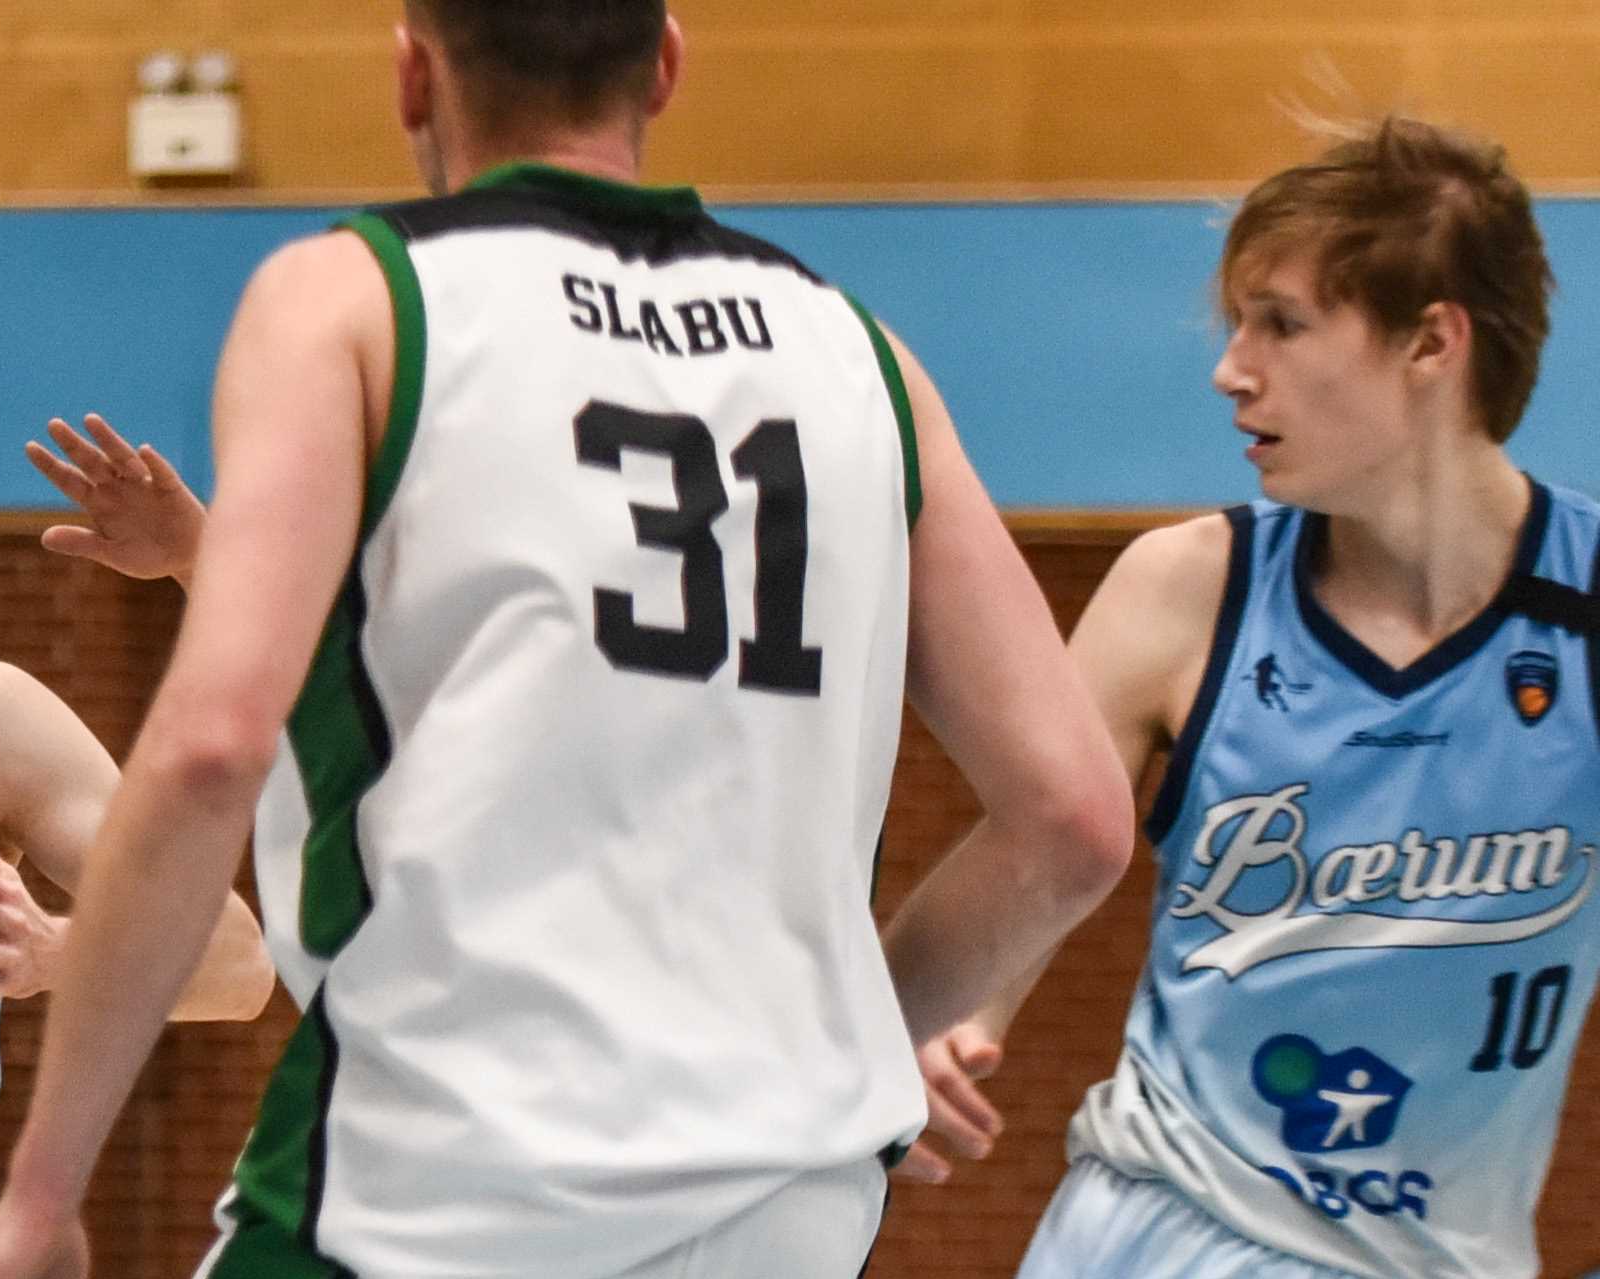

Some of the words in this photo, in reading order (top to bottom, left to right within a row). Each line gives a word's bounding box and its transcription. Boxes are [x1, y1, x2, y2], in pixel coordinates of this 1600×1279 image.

[562, 272, 773, 357] SLABU
[573, 398, 822, 697] 31
[1470, 964, 1571, 1072] 10
